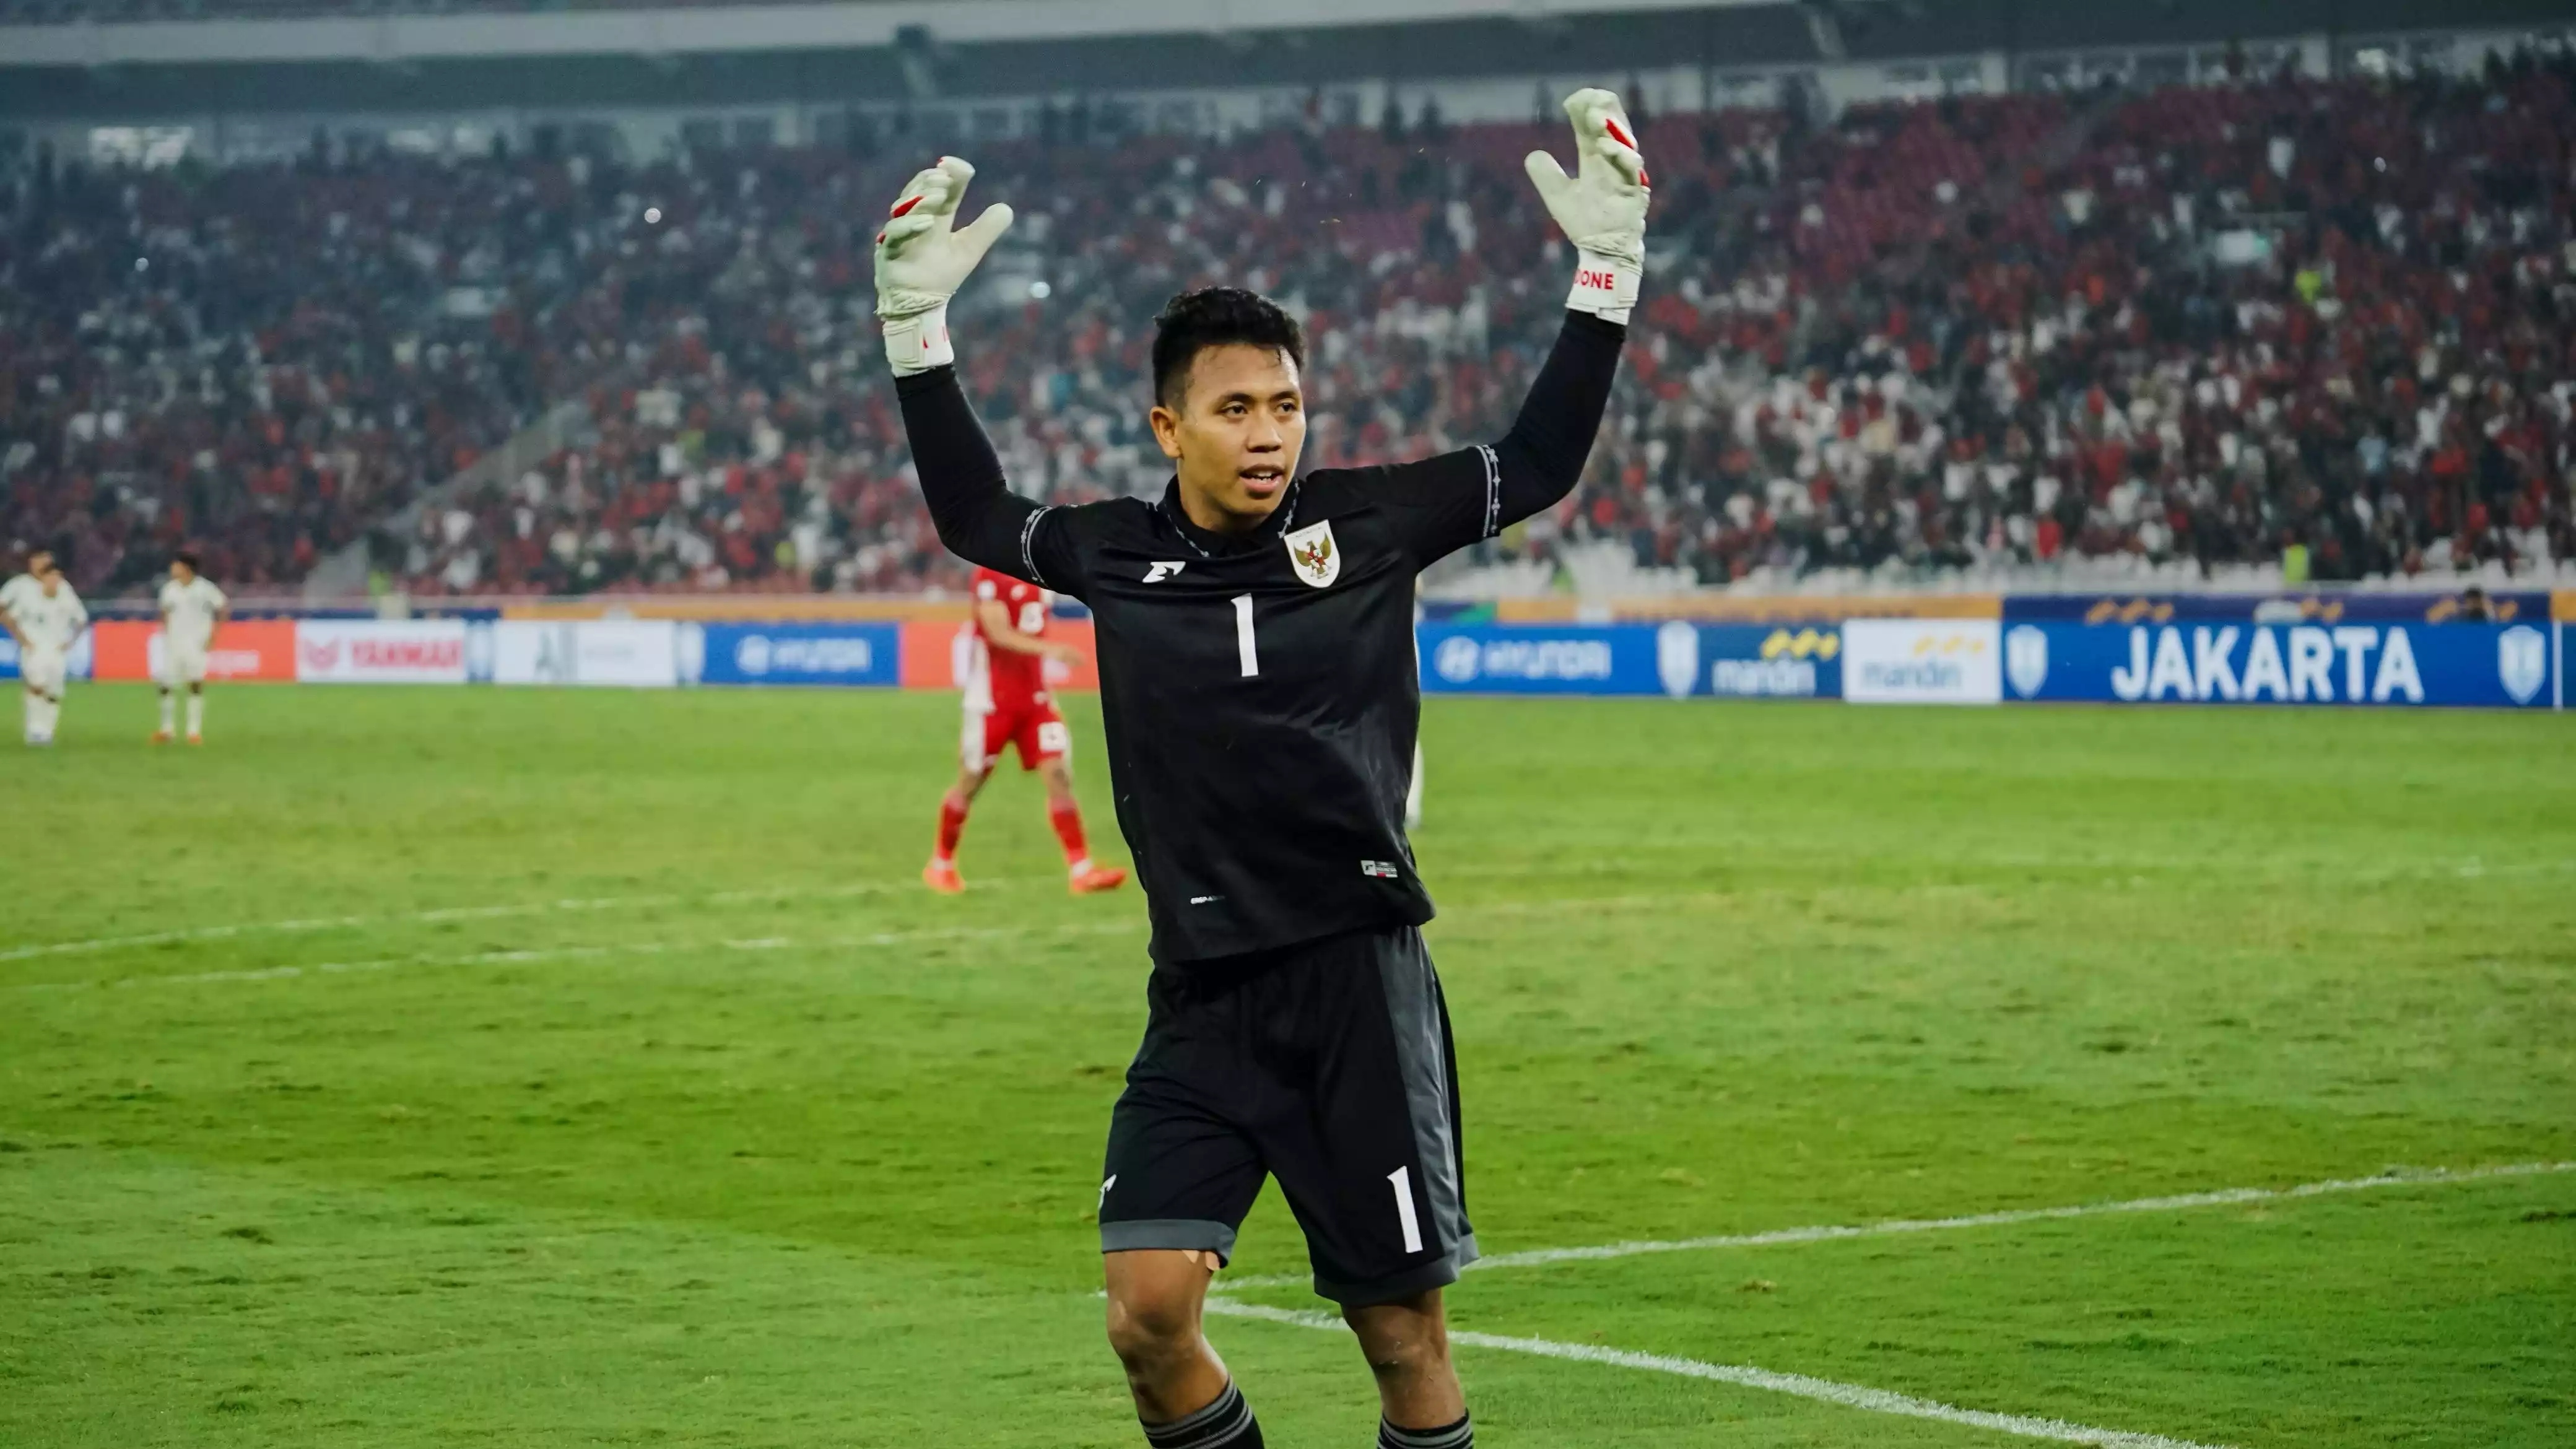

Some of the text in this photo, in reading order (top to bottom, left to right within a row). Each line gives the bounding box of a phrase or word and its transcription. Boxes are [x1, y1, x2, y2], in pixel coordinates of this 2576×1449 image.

[1231, 593, 1259, 677] 1
[2110, 625, 2424, 702] JAKARTA
[1386, 1165, 1424, 1253] 1
